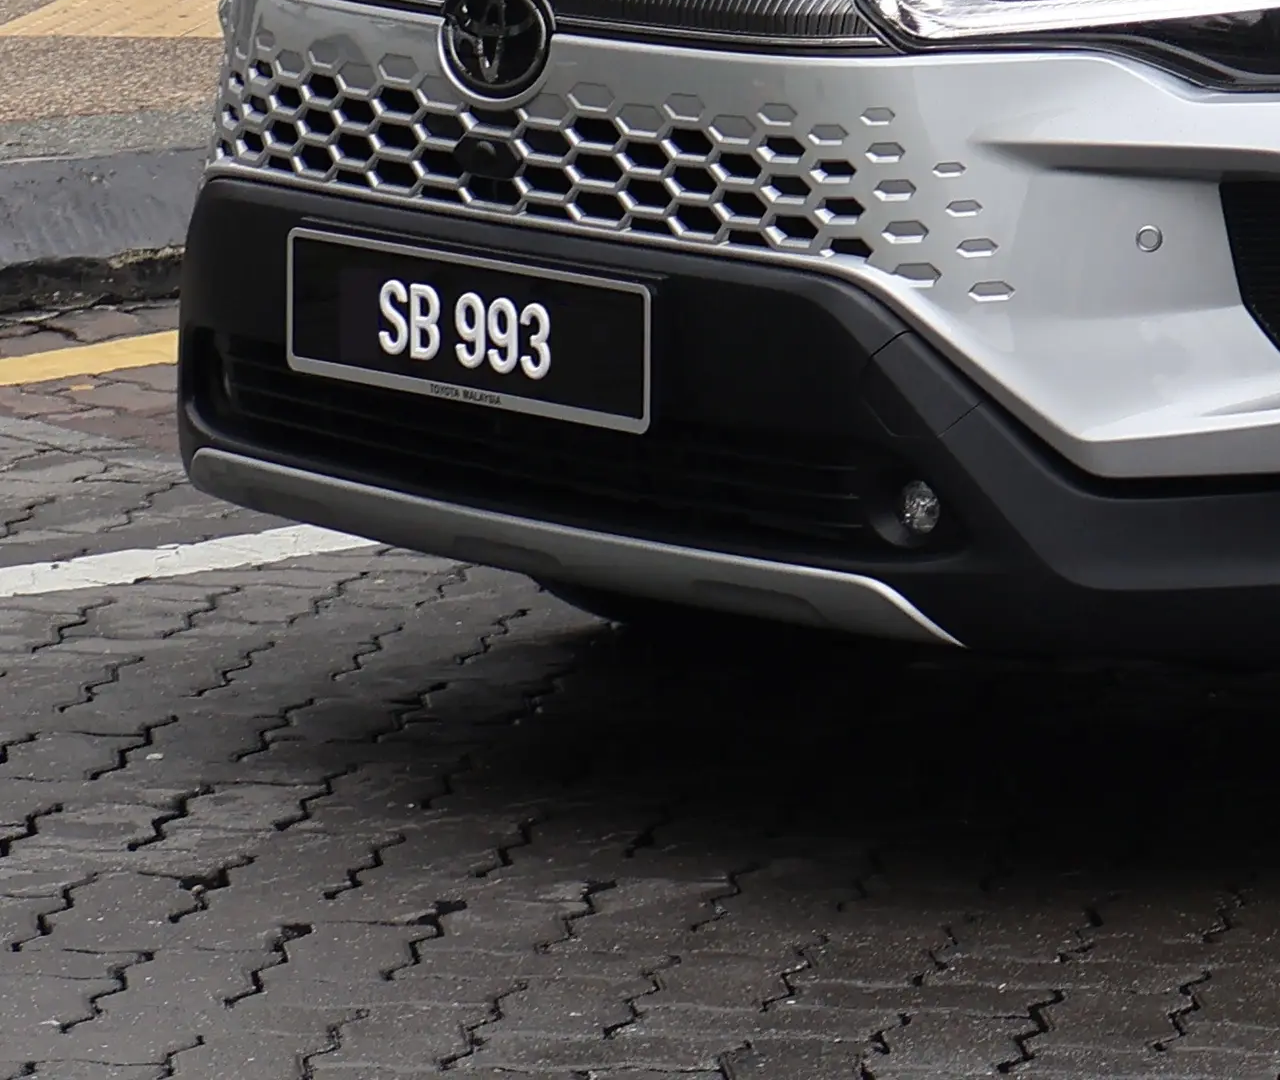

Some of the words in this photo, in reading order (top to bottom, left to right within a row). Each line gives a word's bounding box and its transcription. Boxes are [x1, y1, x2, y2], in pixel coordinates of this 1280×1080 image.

[378, 279, 441, 361] SB
[455, 291, 551, 380] 993
[430, 383, 460, 398] TOYOTA
[462, 389, 502, 406] MALAYSIA
